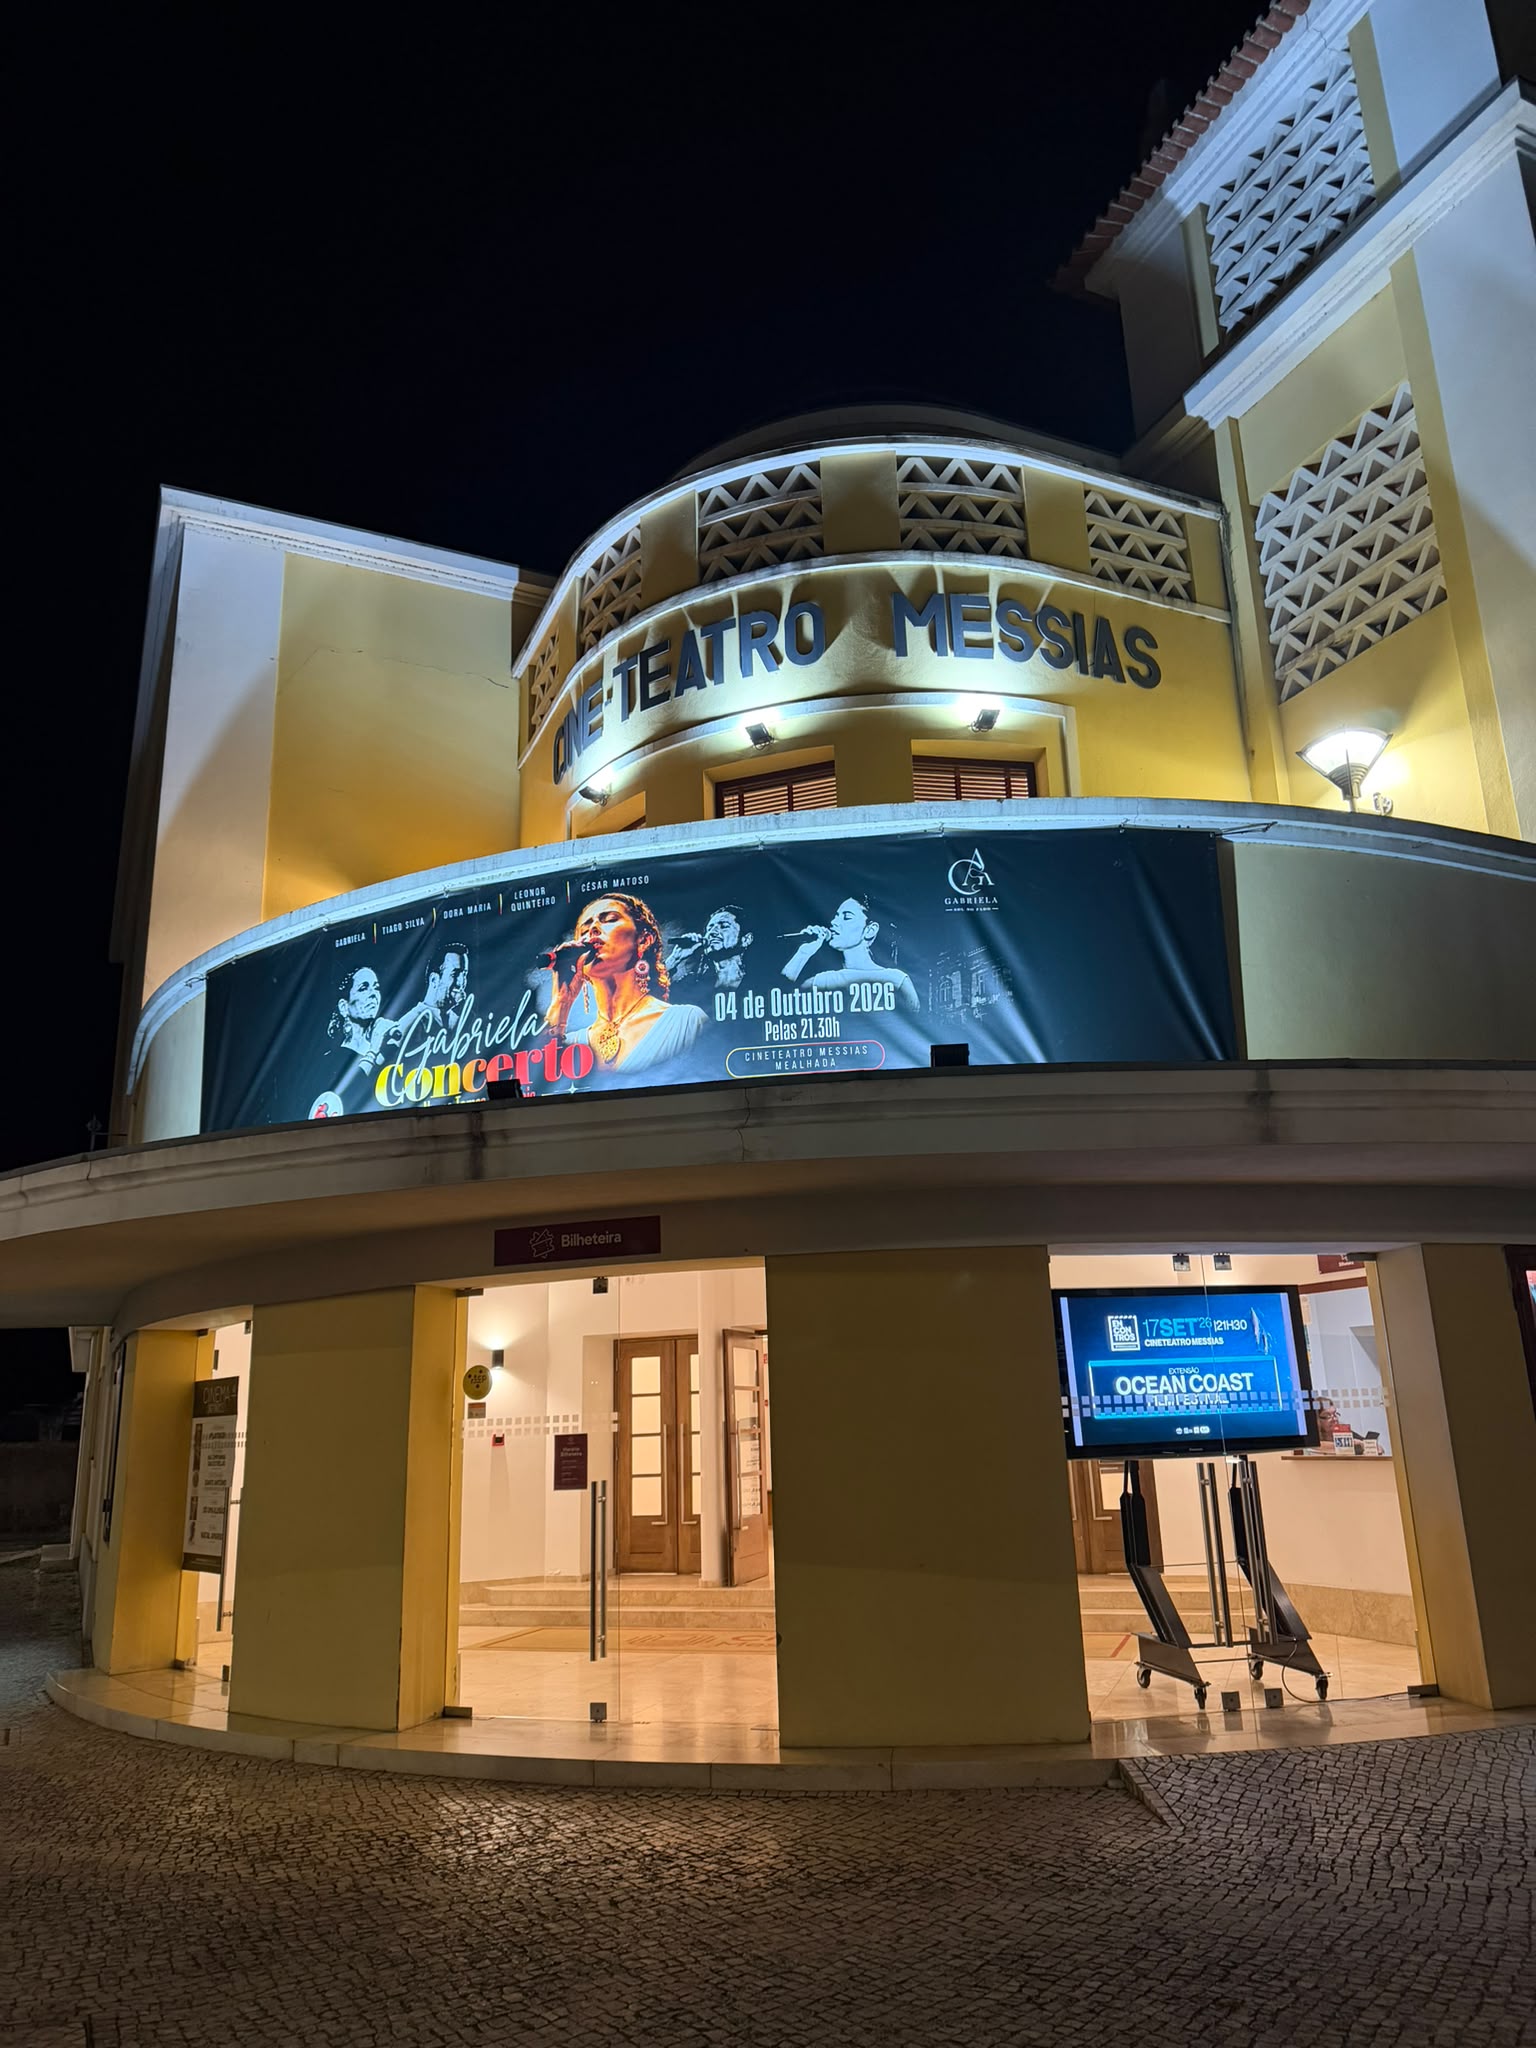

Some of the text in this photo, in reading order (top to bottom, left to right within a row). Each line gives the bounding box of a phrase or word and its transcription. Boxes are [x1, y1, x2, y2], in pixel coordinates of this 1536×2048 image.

[891, 591, 1163, 690] MESSIAS
[581, 875, 650, 893] CÉSAR MATOSO
[514, 886, 546, 900] LEONOR
[944, 896, 998, 905] GABRIELA
[443, 902, 492, 920] DORA MARIA
[510, 896, 556, 912] QUINTEIRO
[382, 917, 425, 935] TIAGO SILVA
[335, 932, 366, 948] GABRIELA
[714, 982, 896, 1022] 04 de Outubro 2026
[765, 1016, 841, 1042] Pelas 21.30h
[392, 989, 549, 1097] Gabriela
[744, 1045, 868, 1062] CINETEATRO MESSIAS
[374, 1038, 594, 1107] Concerto
[775, 1058, 837, 1071] MEALHADA
[561, 1231, 622, 1248] Bilheteira
[1113, 1326, 1132, 1335] CON
[1113, 1333, 1136, 1342] TROS
[1168, 1366, 1200, 1375] EXTENSÃO
[1115, 1372, 1254, 1396] OCEAN COAST
